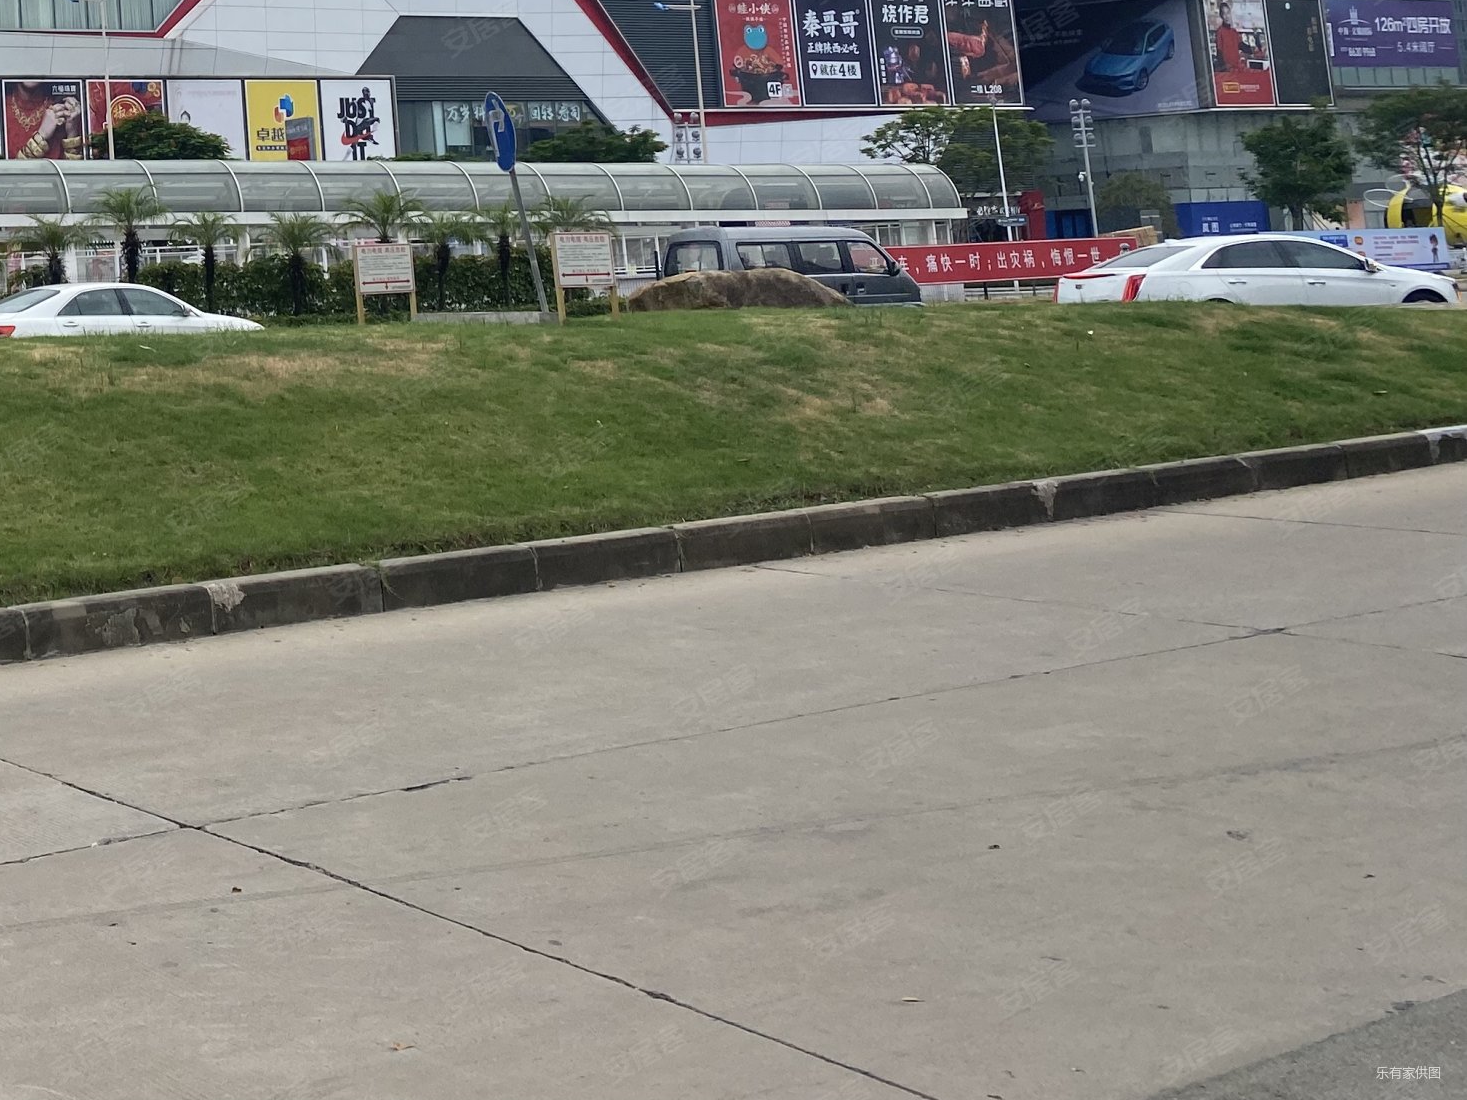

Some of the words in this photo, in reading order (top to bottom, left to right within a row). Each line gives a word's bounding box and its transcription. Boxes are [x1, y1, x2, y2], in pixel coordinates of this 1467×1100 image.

[802, 9, 860, 39] 秦哥哥
[768, 83, 782, 95] 4F
